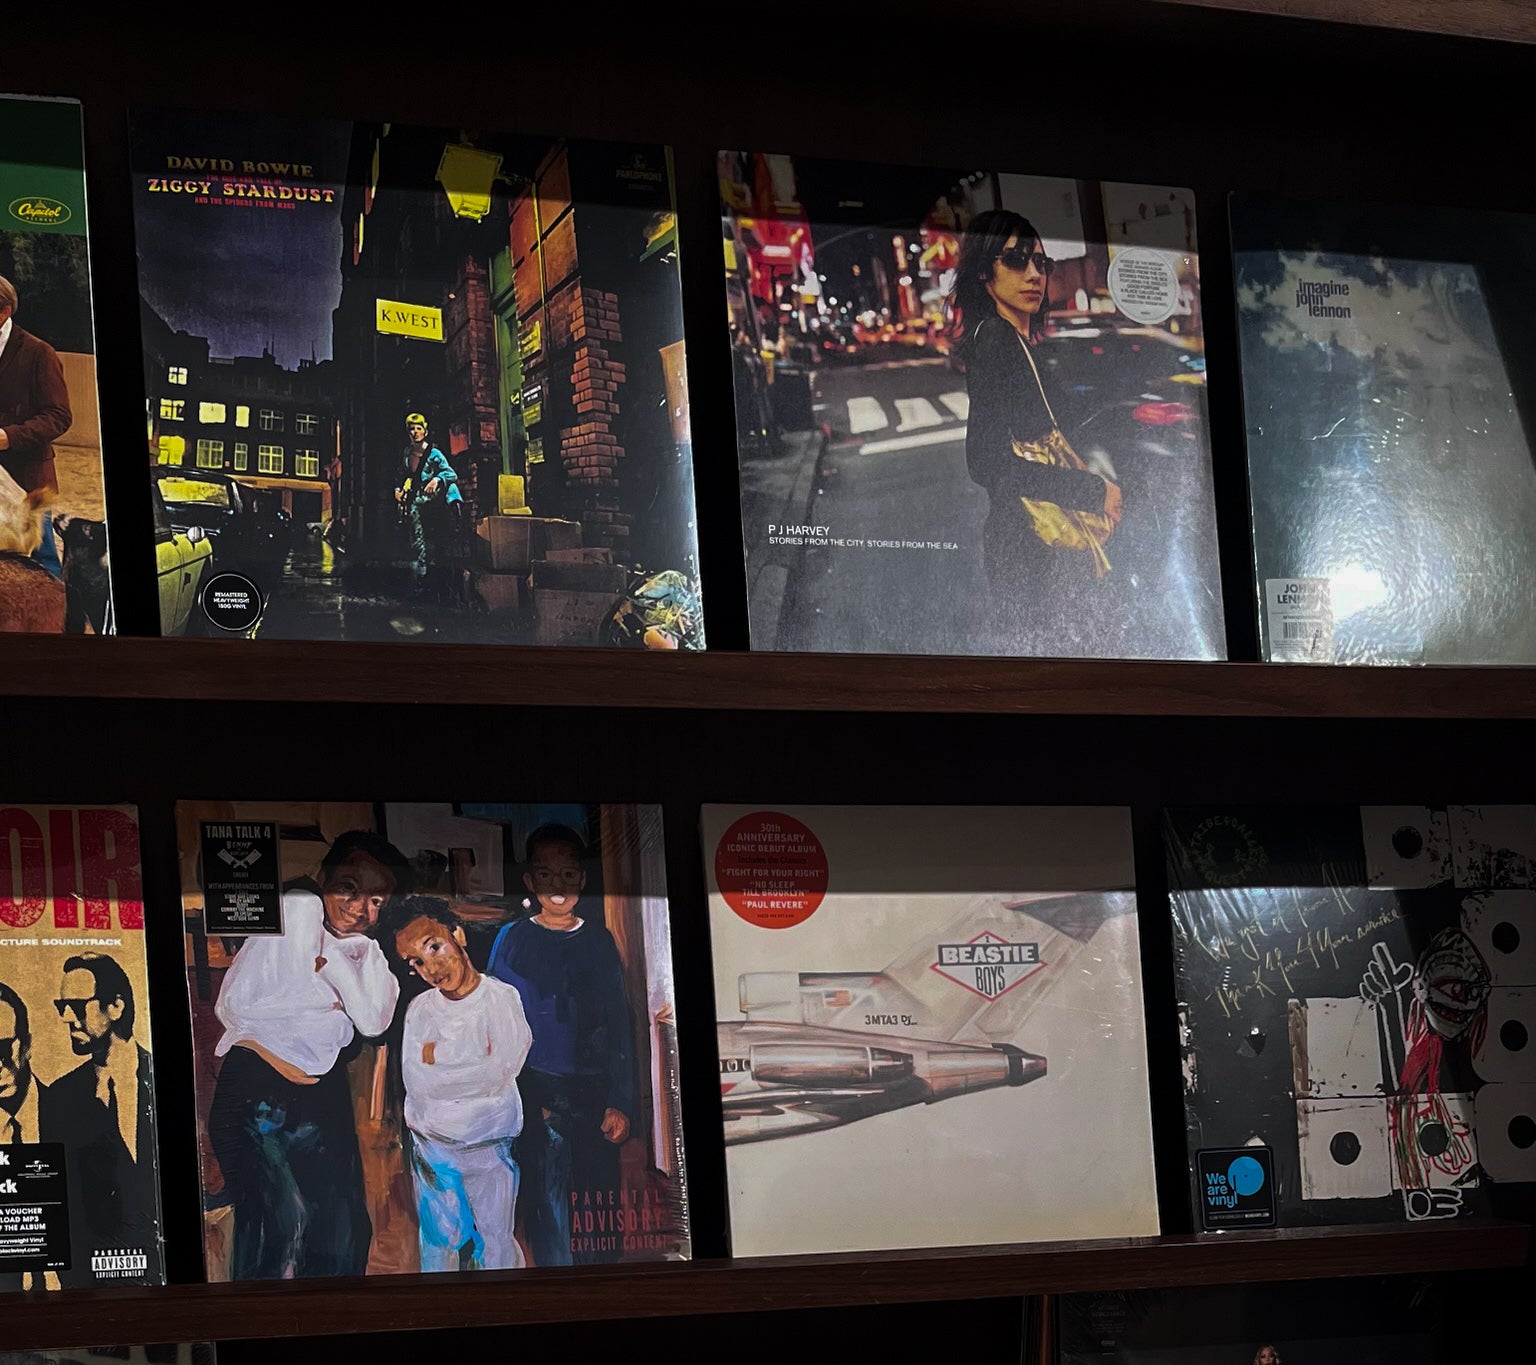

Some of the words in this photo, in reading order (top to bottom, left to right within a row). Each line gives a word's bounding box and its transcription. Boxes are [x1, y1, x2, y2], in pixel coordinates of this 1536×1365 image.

[166, 155, 236, 172] DAVID
[242, 160, 315, 178] BOWIE
[147, 178, 212, 195] ZIGGY
[223, 182, 336, 203] STARDUST
[18, 203, 62, 217] Capitol
[1299, 278, 1349, 297] imagine
[1296, 290, 1323, 308] john
[1308, 305, 1351, 318] lennon
[381, 308, 439, 329] K.WEST
[768, 525, 775, 534] P
[778, 525, 784, 535] J
[786, 525, 830, 536] HARVEY
[769, 537, 804, 546] STORIES
[805, 538, 829, 546] FROM
[830, 538, 846, 547] THE
[867, 541, 901, 549] STORIES
[902, 541, 925, 549] FROM
[926, 542, 941, 550] THE
[942, 542, 959, 551] SEA
[205, 825, 232, 839] TANA
[235, 825, 261, 839] TALK
[264, 825, 271, 839] 4
[760, 823, 781, 833] 30th
[737, 833, 806, 842] ANNIVERSARY
[727, 844, 757, 852] ICONIC
[758, 844, 786, 853] DEBUT
[787, 845, 817, 853] ALBUM
[0, 807, 144, 930] OIR
[753, 869, 769, 877] FOR
[770, 869, 793, 877] YOUR
[769, 881, 795, 889] SLEEP
[743, 888, 760, 897] TILL
[42, 938, 122, 946] SOUNDTRACK
[942, 945, 1036, 964] BEASTIE
[975, 966, 1005, 996] BOYS
[1206, 1172, 1227, 1185] We
[1208, 1185, 1228, 1195] are
[571, 1189, 661, 1207] PARENTAL
[1208, 1188, 1238, 1208] vinyl
[5, 1207, 43, 1215] VOUCHER
[22, 1215, 39, 1223] MP3
[572, 1207, 663, 1233] ADVISORY
[4, 1224, 18, 1232] THE
[20, 1223, 46, 1232] ALBUM
[570, 1236, 617, 1252] EXPLICIT
[623, 1234, 667, 1251] CONTENT
[94, 1248, 143, 1257] PARENTAL
[95, 1257, 144, 1269] ADVISORY
